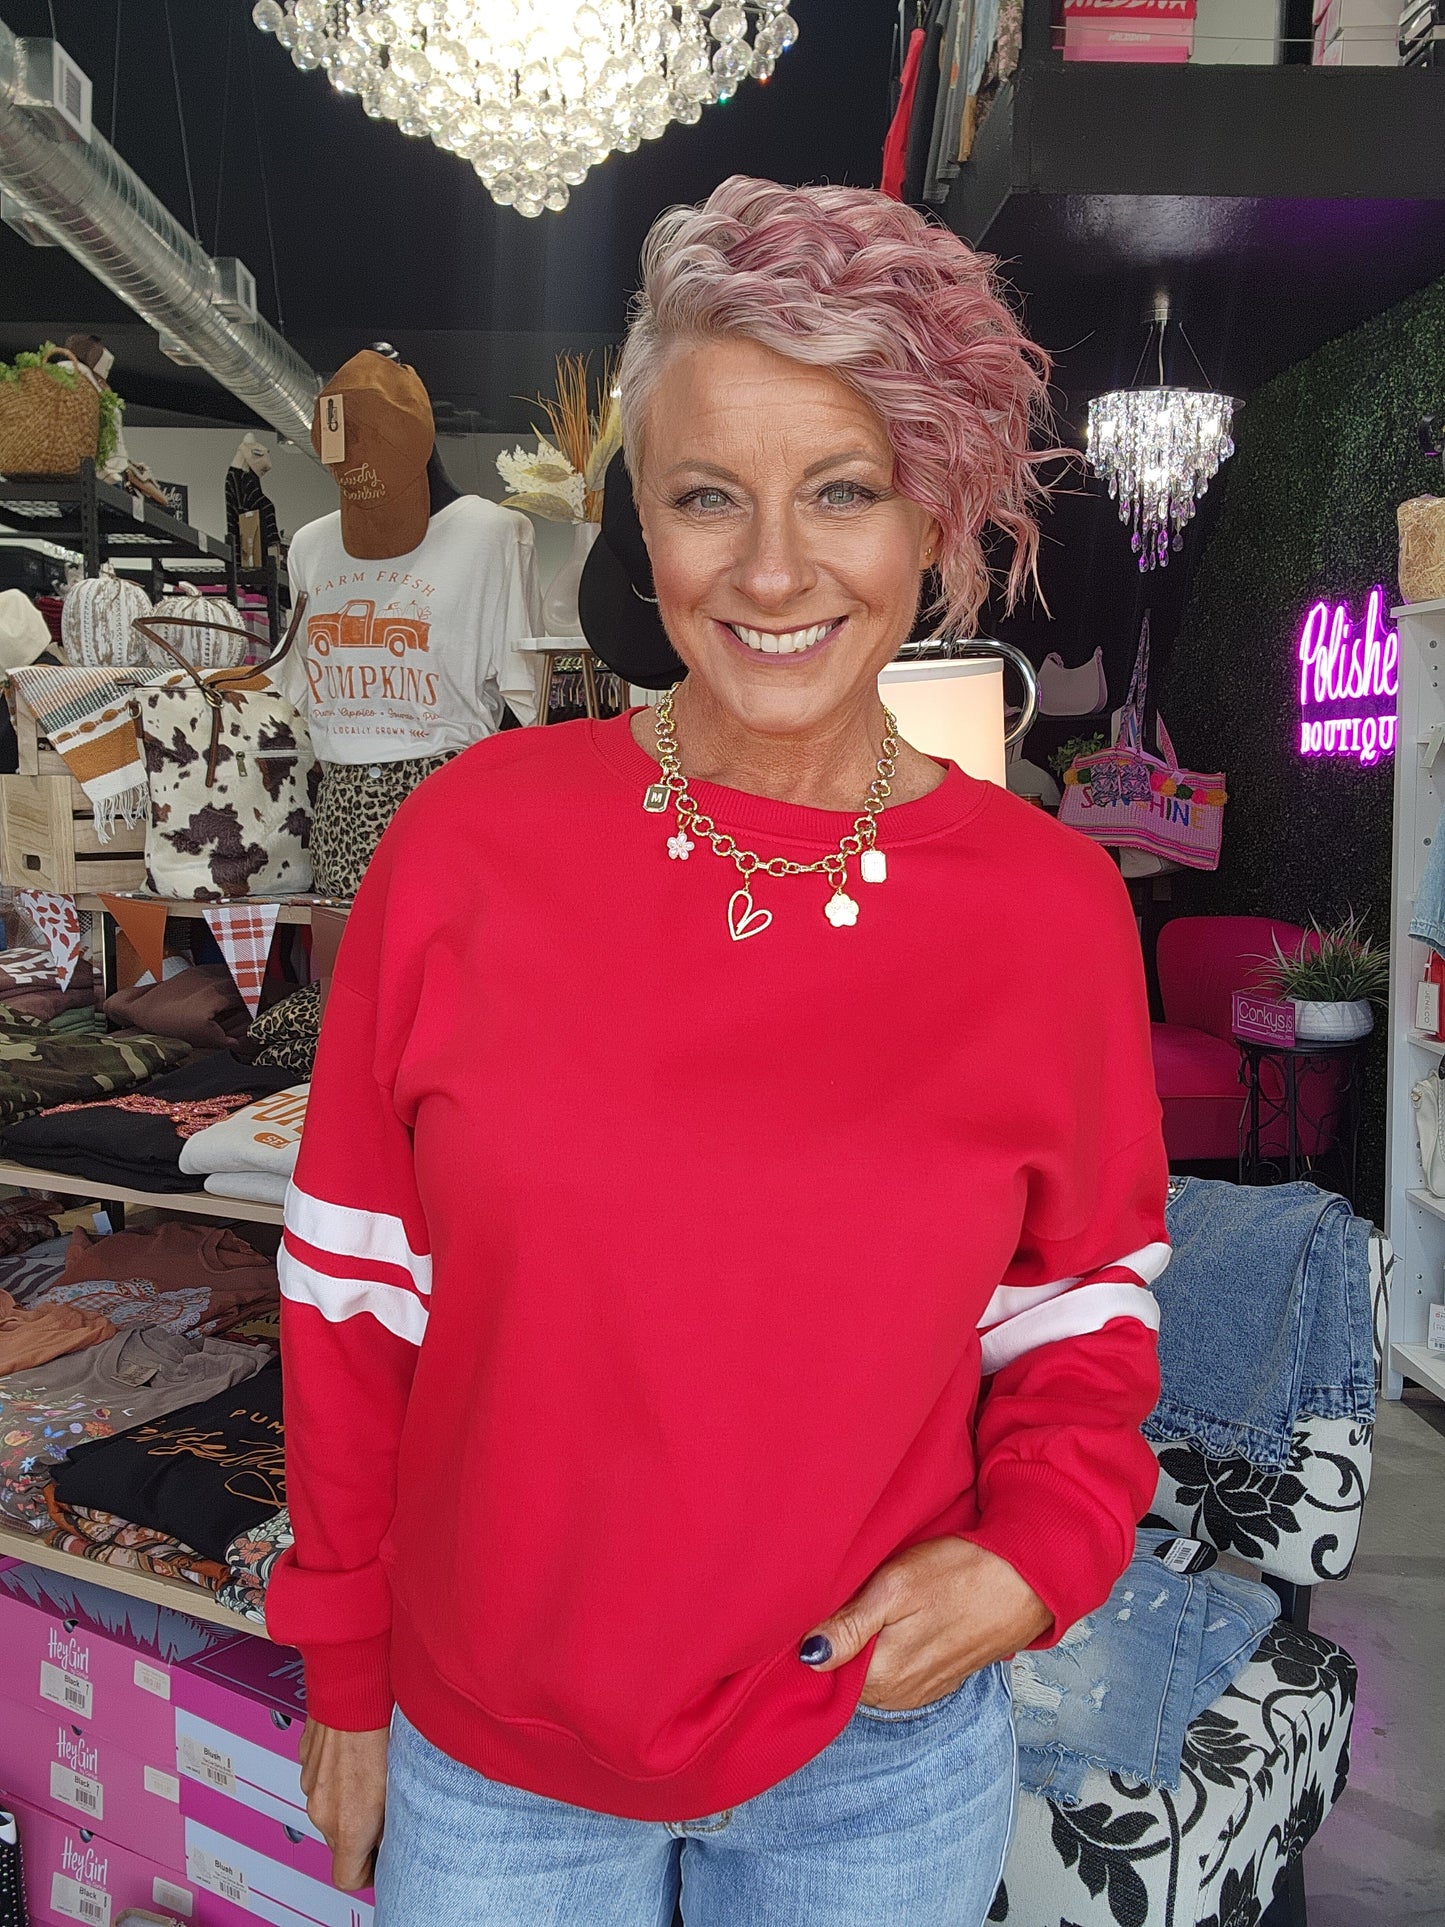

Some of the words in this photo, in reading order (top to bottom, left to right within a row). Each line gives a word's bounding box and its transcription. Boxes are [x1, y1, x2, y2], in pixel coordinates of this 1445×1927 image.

[315, 572, 366, 596] FARM
[376, 570, 436, 597] FRESH
[1299, 590, 1399, 706] Polishe
[306, 657, 440, 706] PUMPKINS
[333, 726, 371, 735] LOCALLY
[375, 726, 405, 736] GROWN
[1300, 715, 1398, 761] BOUTIQU
[651, 792, 662, 803] M
[1239, 1001, 1285, 1033] Corkys
[229, 1409, 285, 1435] PUM
[64, 1674, 80, 1687] Black
[203, 1747, 221, 1761] Blush
[74, 1775, 90, 1788] Black
[214, 1859, 233, 1875] Blush
[79, 1886, 97, 1899] Black
